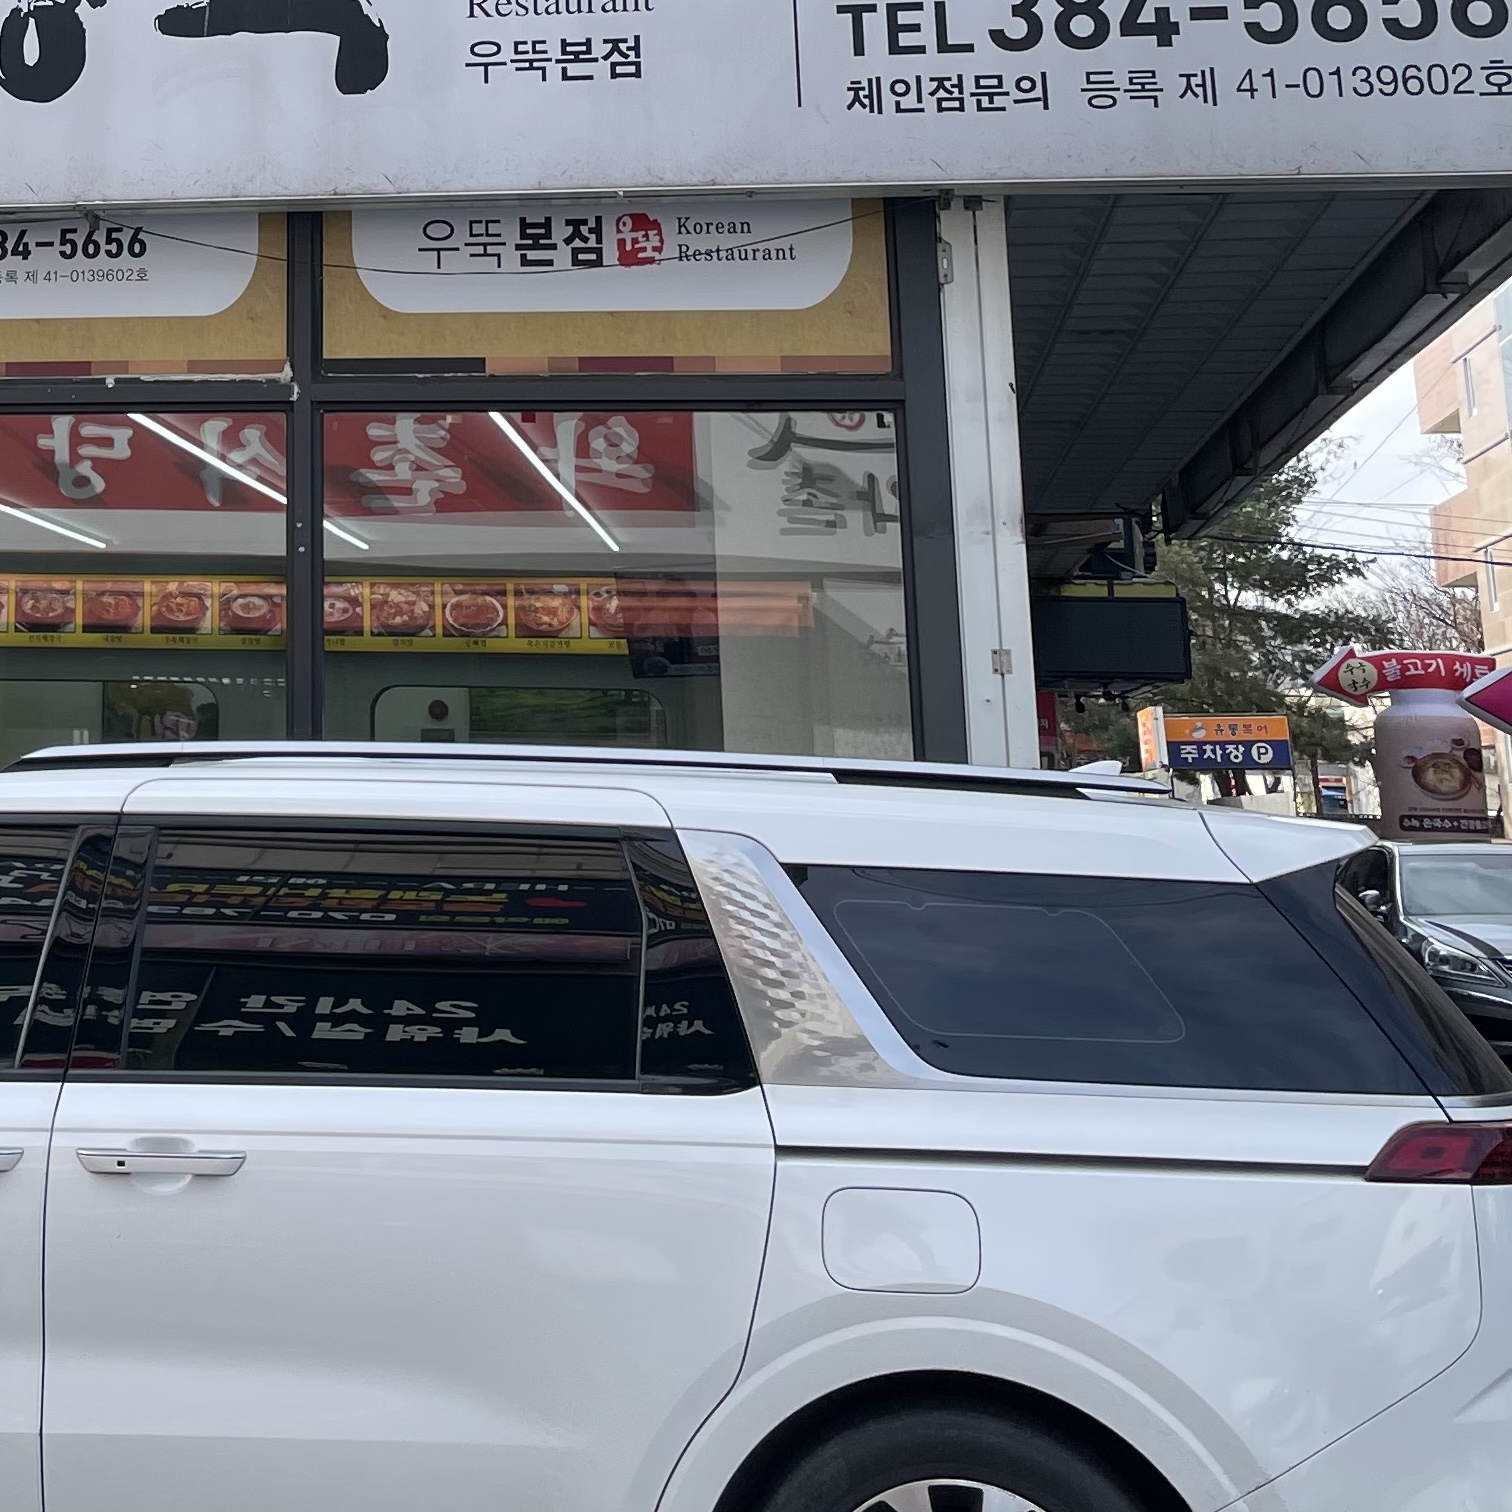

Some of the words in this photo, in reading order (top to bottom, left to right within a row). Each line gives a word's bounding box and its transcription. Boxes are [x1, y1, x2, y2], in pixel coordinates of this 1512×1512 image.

[836, 0, 976, 58] TEL
[465, 34, 643, 85] 우뚝본점
[845, 70, 1051, 115] 체인점문의
[1079, 68, 1165, 110] 등록
[1178, 65, 1219, 108] 제
[676, 216, 752, 236] Korean
[417, 214, 604, 270] 우뚝본점
[676, 242, 797, 263] Restaurant
[23, 267, 39, 285] 제
[42, 265, 150, 285] 41-0139602호
[1381, 658, 1446, 683] 불고기
[1179, 744, 1246, 763] 주차장
